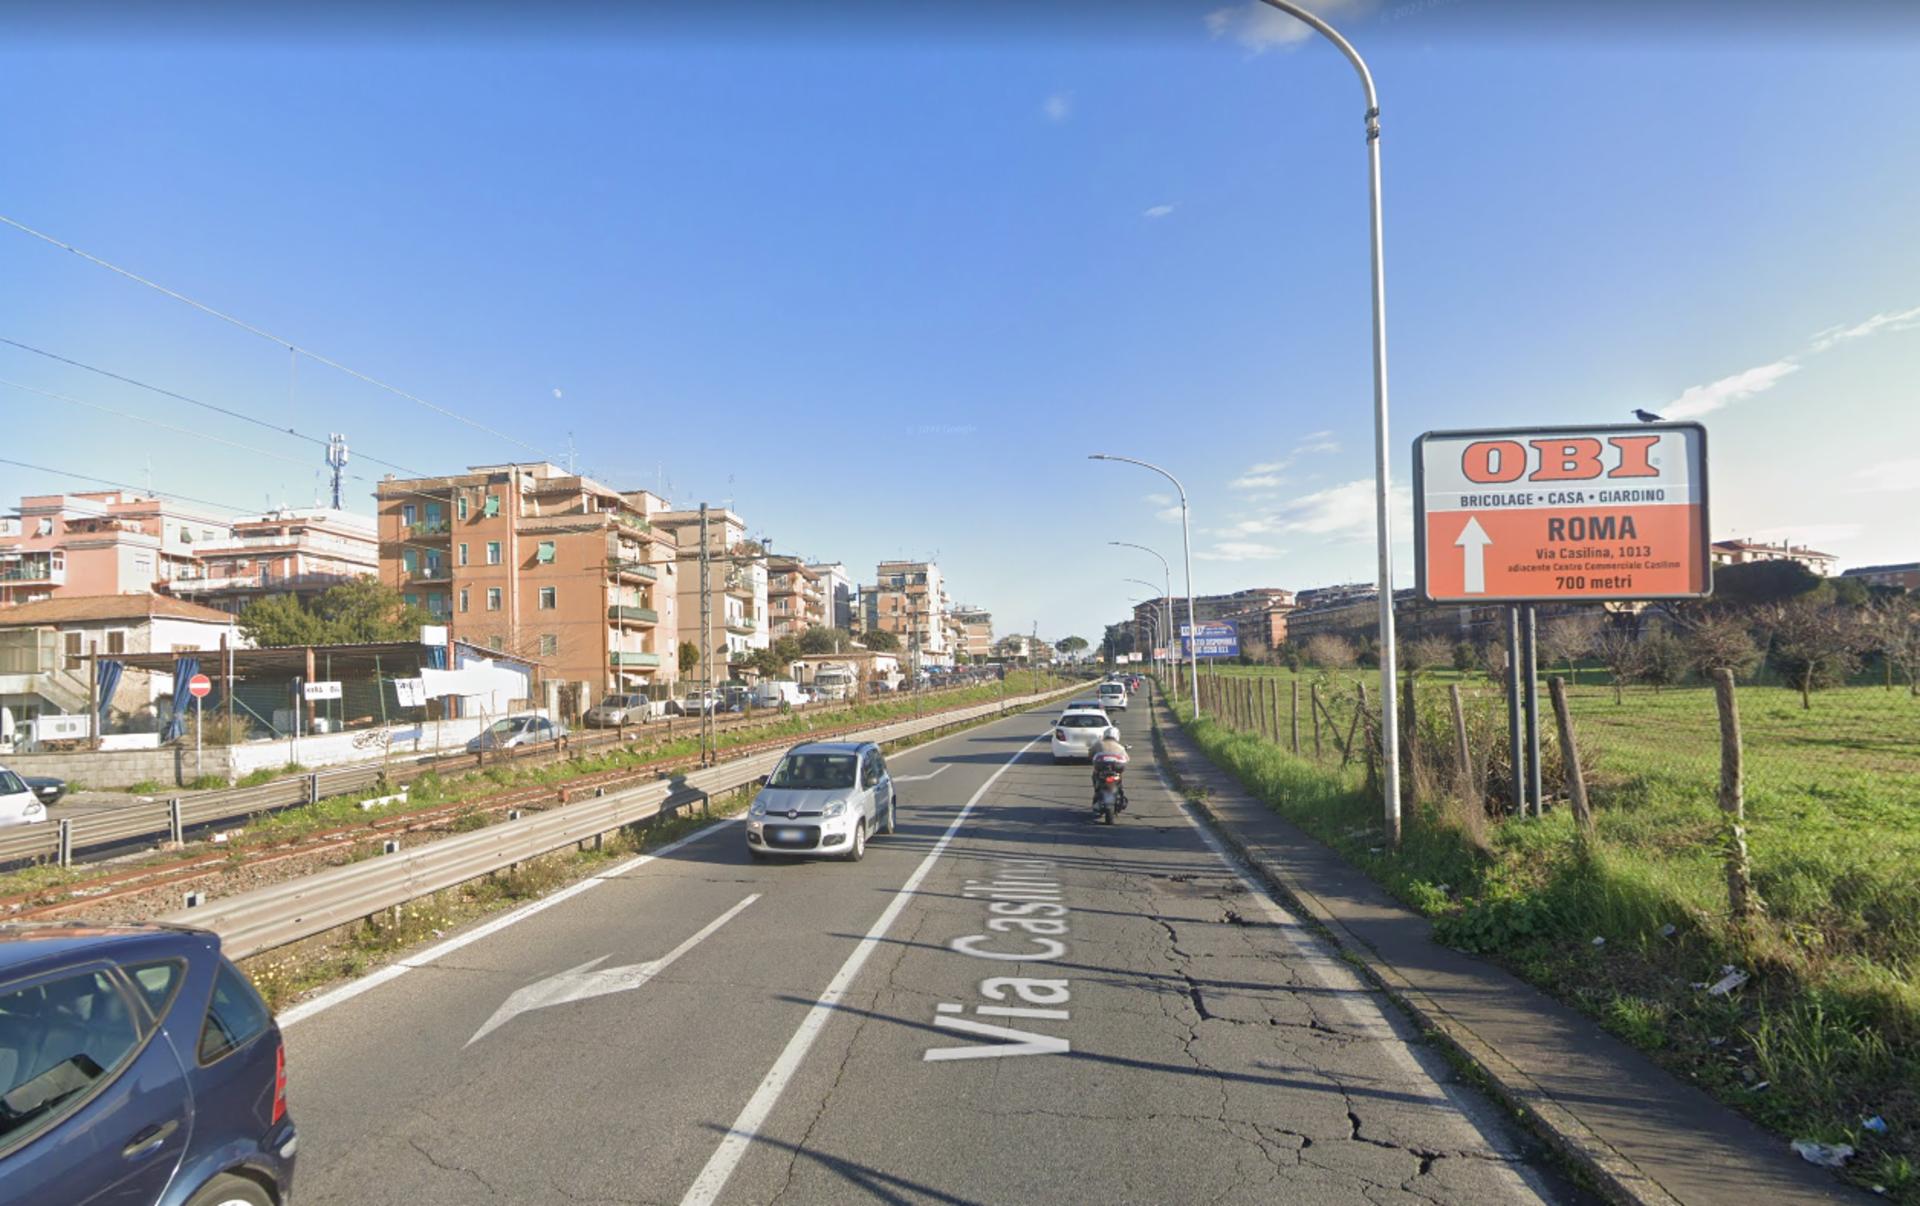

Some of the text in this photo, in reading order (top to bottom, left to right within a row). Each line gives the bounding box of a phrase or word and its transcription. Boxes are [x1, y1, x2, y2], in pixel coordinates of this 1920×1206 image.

[1461, 435, 1661, 484] OBI
[1460, 489, 1665, 508] BRICOLAGE CASA GIARDINO
[1548, 516, 1637, 542] ROMA
[1536, 546, 1651, 560] Via Casilina, 1013
[1507, 560, 1681, 573] adiacente Centro Commerciale Casilino
[1555, 575, 1632, 590] 700 metri
[923, 976, 1070, 1062] Via
